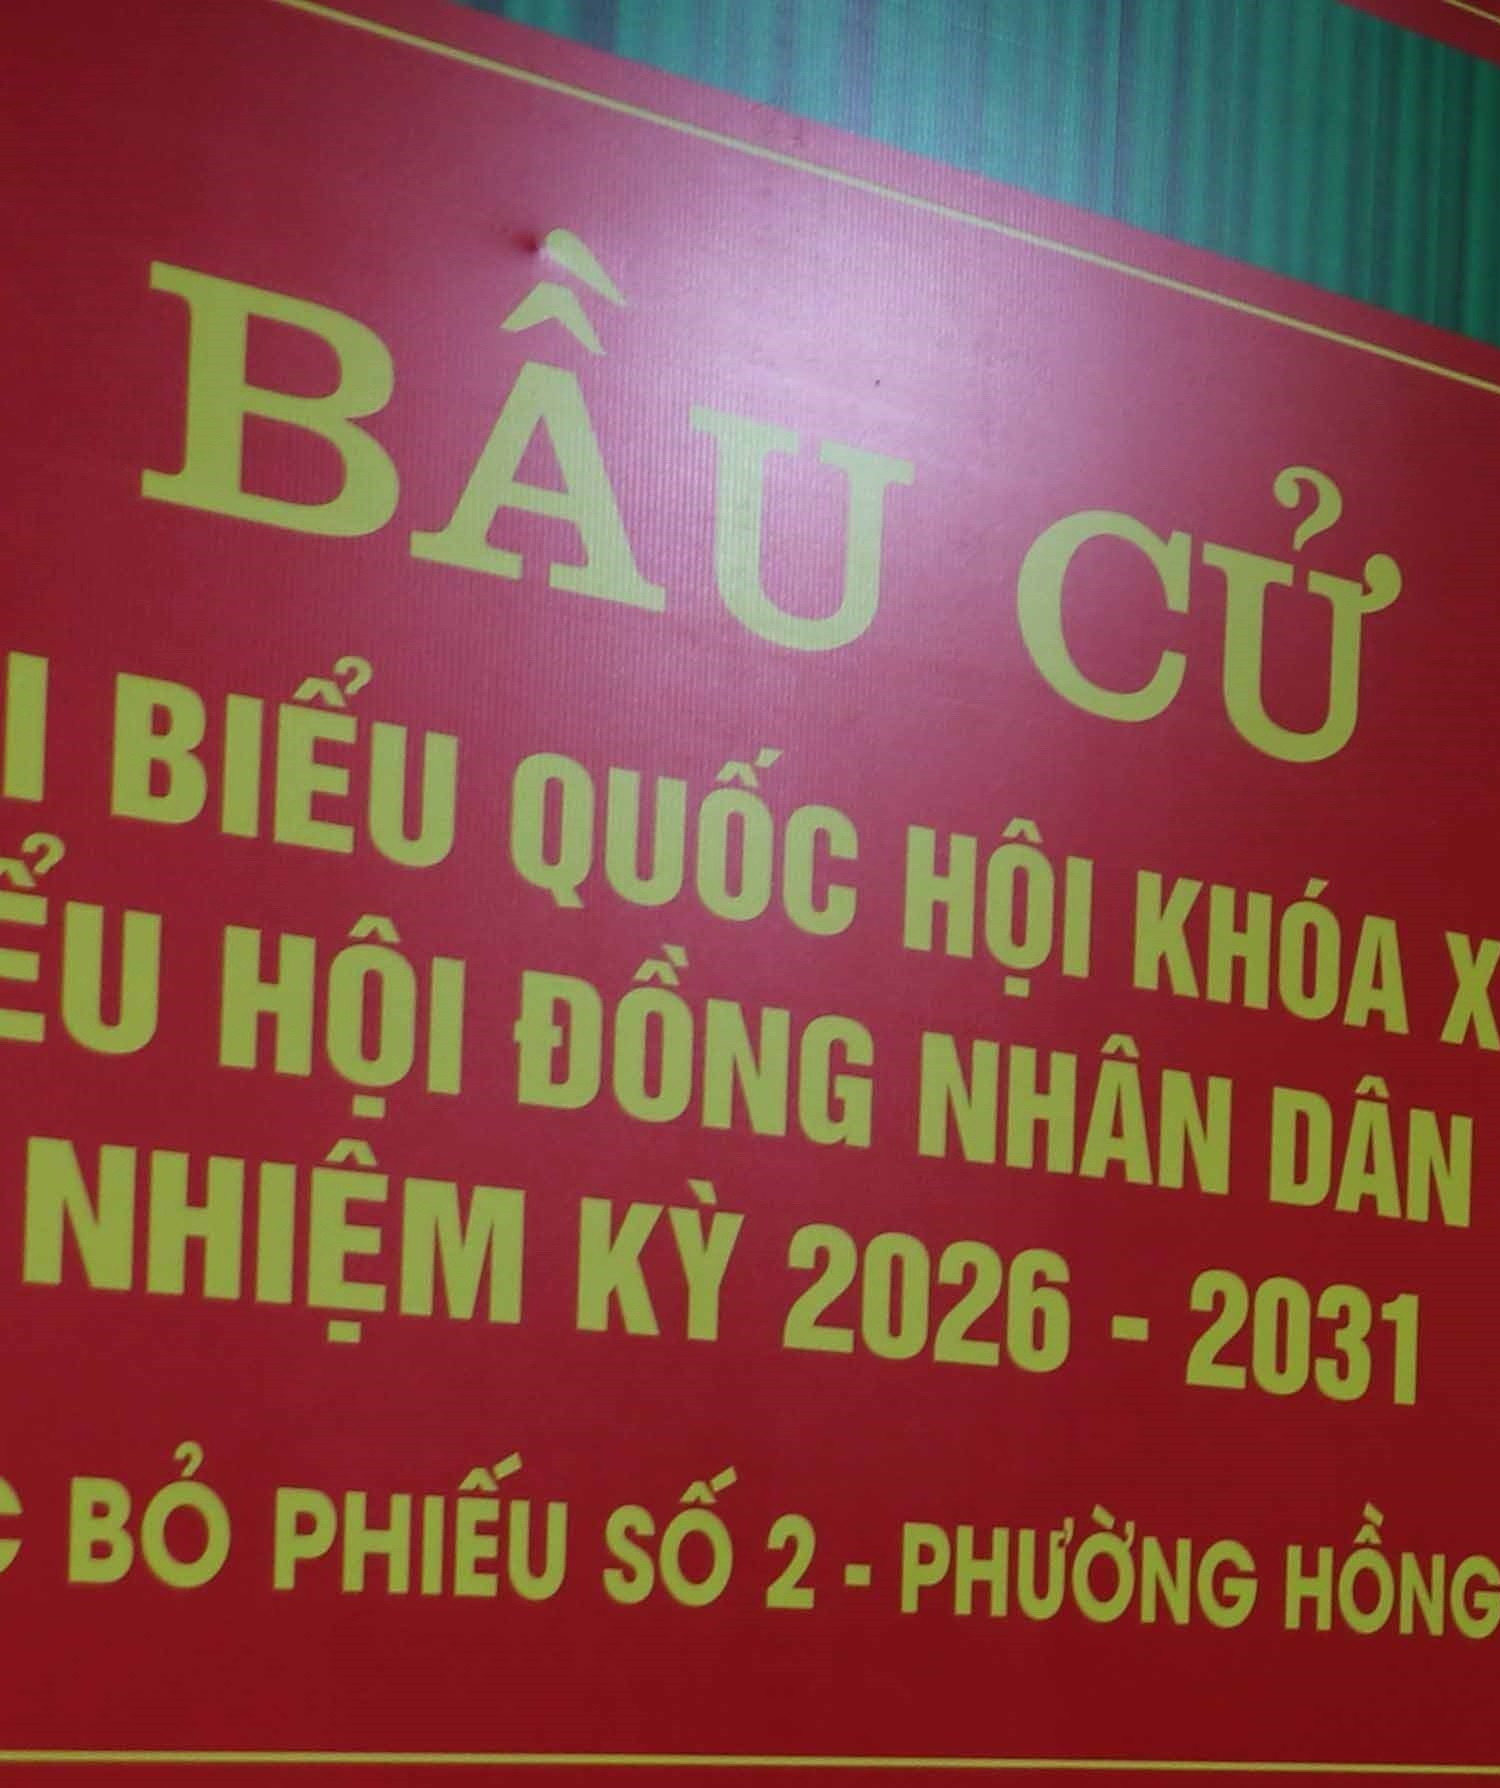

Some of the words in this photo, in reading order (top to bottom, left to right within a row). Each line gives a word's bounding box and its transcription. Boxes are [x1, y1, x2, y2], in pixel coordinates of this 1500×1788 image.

[141, 228, 915, 652] BẦU
[1016, 466, 1402, 762] CỬ
[112, 656, 456, 867] BIỂU
[510, 748, 858, 908] QUỐC
[904, 818, 1092, 996] HỘI
[1134, 878, 1407, 1033] KHÓA
[220, 916, 464, 1117] HỘI
[514, 946, 873, 1147] ĐỒNG
[919, 1032, 1231, 1193] NHÂN
[1271, 1077, 1472, 1226] DÂN
[24, 1138, 523, 1342] NHIỆM
[578, 1180, 743, 1340] KỲ
[784, 1224, 1069, 1371] 2026
[1187, 1270, 1418, 1404] 2031
[69, 1443, 229, 1587] BỎ
[275, 1455, 566, 1599] PHIẾU
[604, 1469, 735, 1605] SỐ
[767, 1515, 814, 1608] 2
[902, 1508, 1256, 1627] PHƯỜNG
